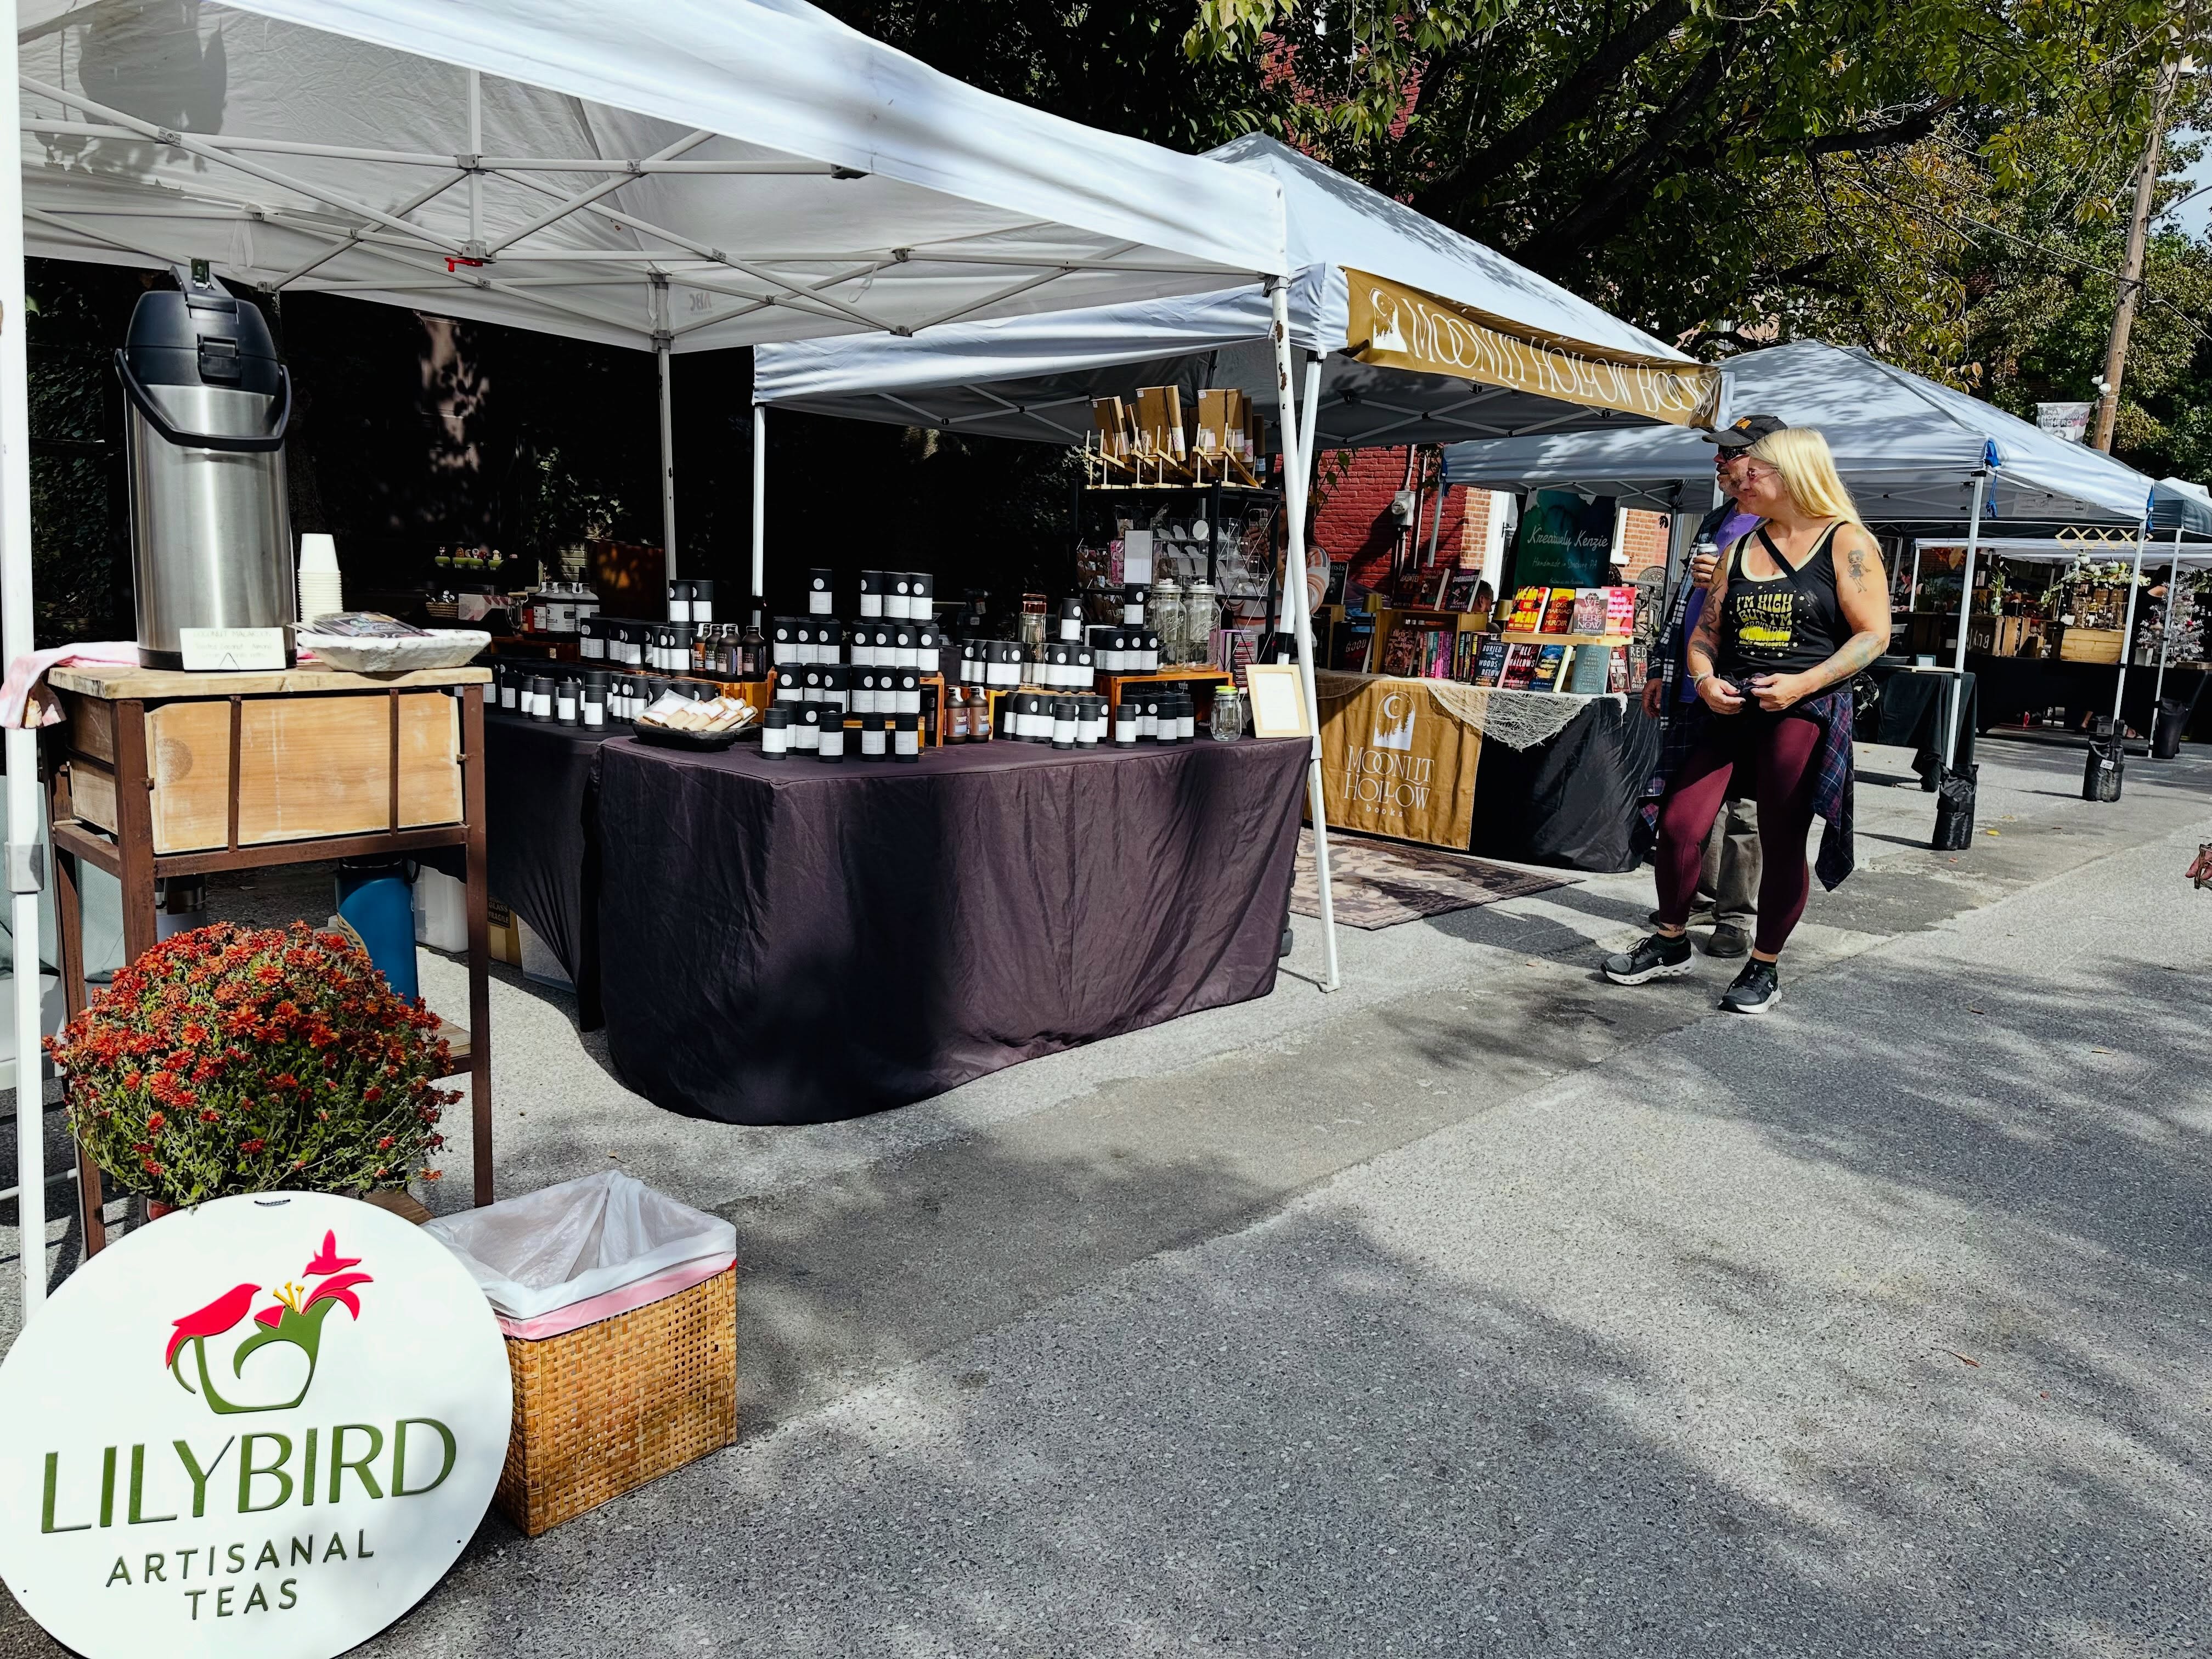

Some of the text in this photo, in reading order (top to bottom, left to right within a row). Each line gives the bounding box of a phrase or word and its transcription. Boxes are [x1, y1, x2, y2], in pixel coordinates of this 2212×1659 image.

[1401, 298, 1714, 417] MOONLIT HOLLOW BOOKS
[1527, 524, 1608, 552] Kreatively Kenzie
[1532, 557, 1560, 567] Handmade
[1584, 599, 1600, 607] WE
[1736, 594, 1794, 613] I'M HIGH
[1515, 611, 1538, 624] DEAD
[1577, 614, 1602, 622] HERE
[1738, 608, 1792, 626] BUT I'M
[1577, 621, 1602, 629] NOW
[1482, 645, 1502, 653] BURIED
[1520, 646, 1532, 656] ALL
[1630, 646, 1647, 658] RED
[1509, 658, 1536, 668] HALLOWS
[1481, 669, 1500, 677] BELOW
[1346, 745, 1435, 785] MOONLIT
[1344, 772, 1430, 811] HOLLOW
[1365, 803, 1403, 817] books
[488, 901, 508, 913] GLASS
[488, 911, 509, 923] FRAGILE
[41, 1417, 456, 1534] LILYBIRD
[106, 1528, 374, 1587] ARTISANAL
[184, 1578, 298, 1621] TEAS
